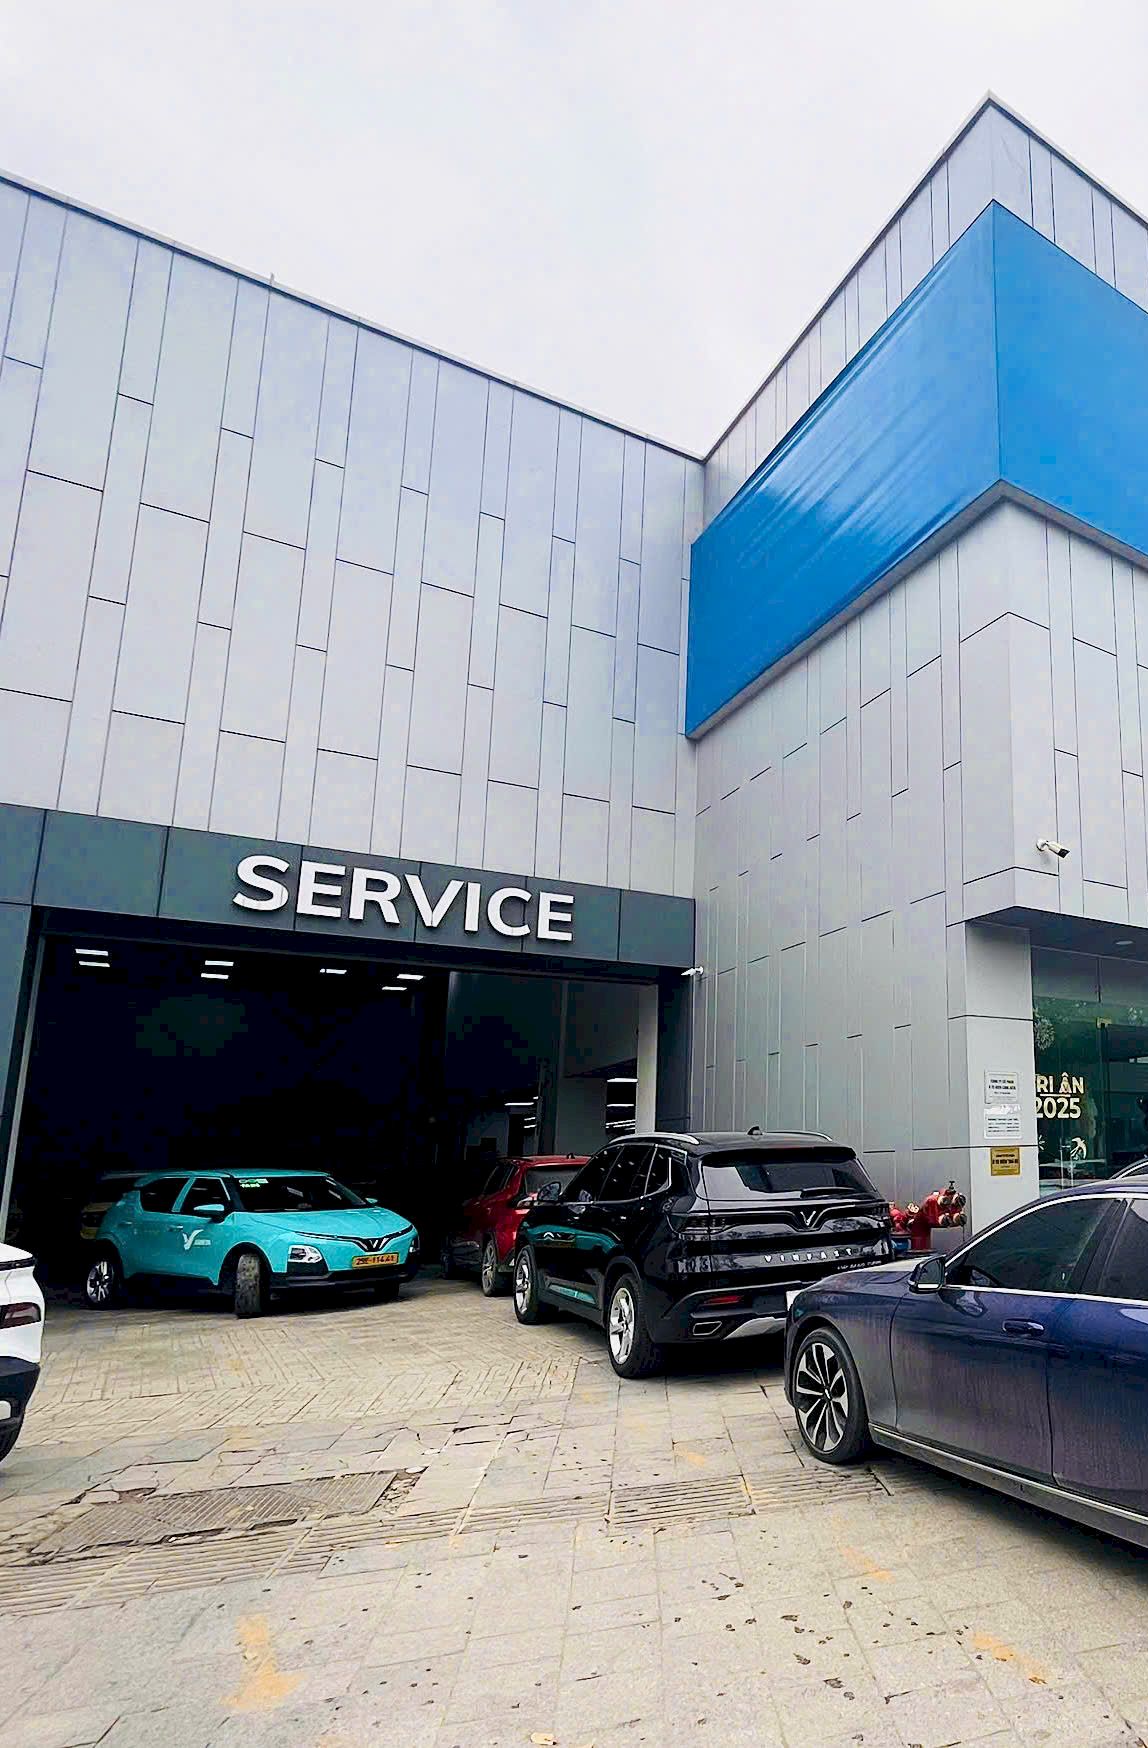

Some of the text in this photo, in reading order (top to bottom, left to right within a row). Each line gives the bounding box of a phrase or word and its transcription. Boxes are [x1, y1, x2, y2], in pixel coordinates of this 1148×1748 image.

[232, 855, 575, 942] SERVICE
[1035, 1074, 1054, 1093] RI
[1035, 1096, 1081, 1119] 2025
[764, 1248, 852, 1262] VINFAST
